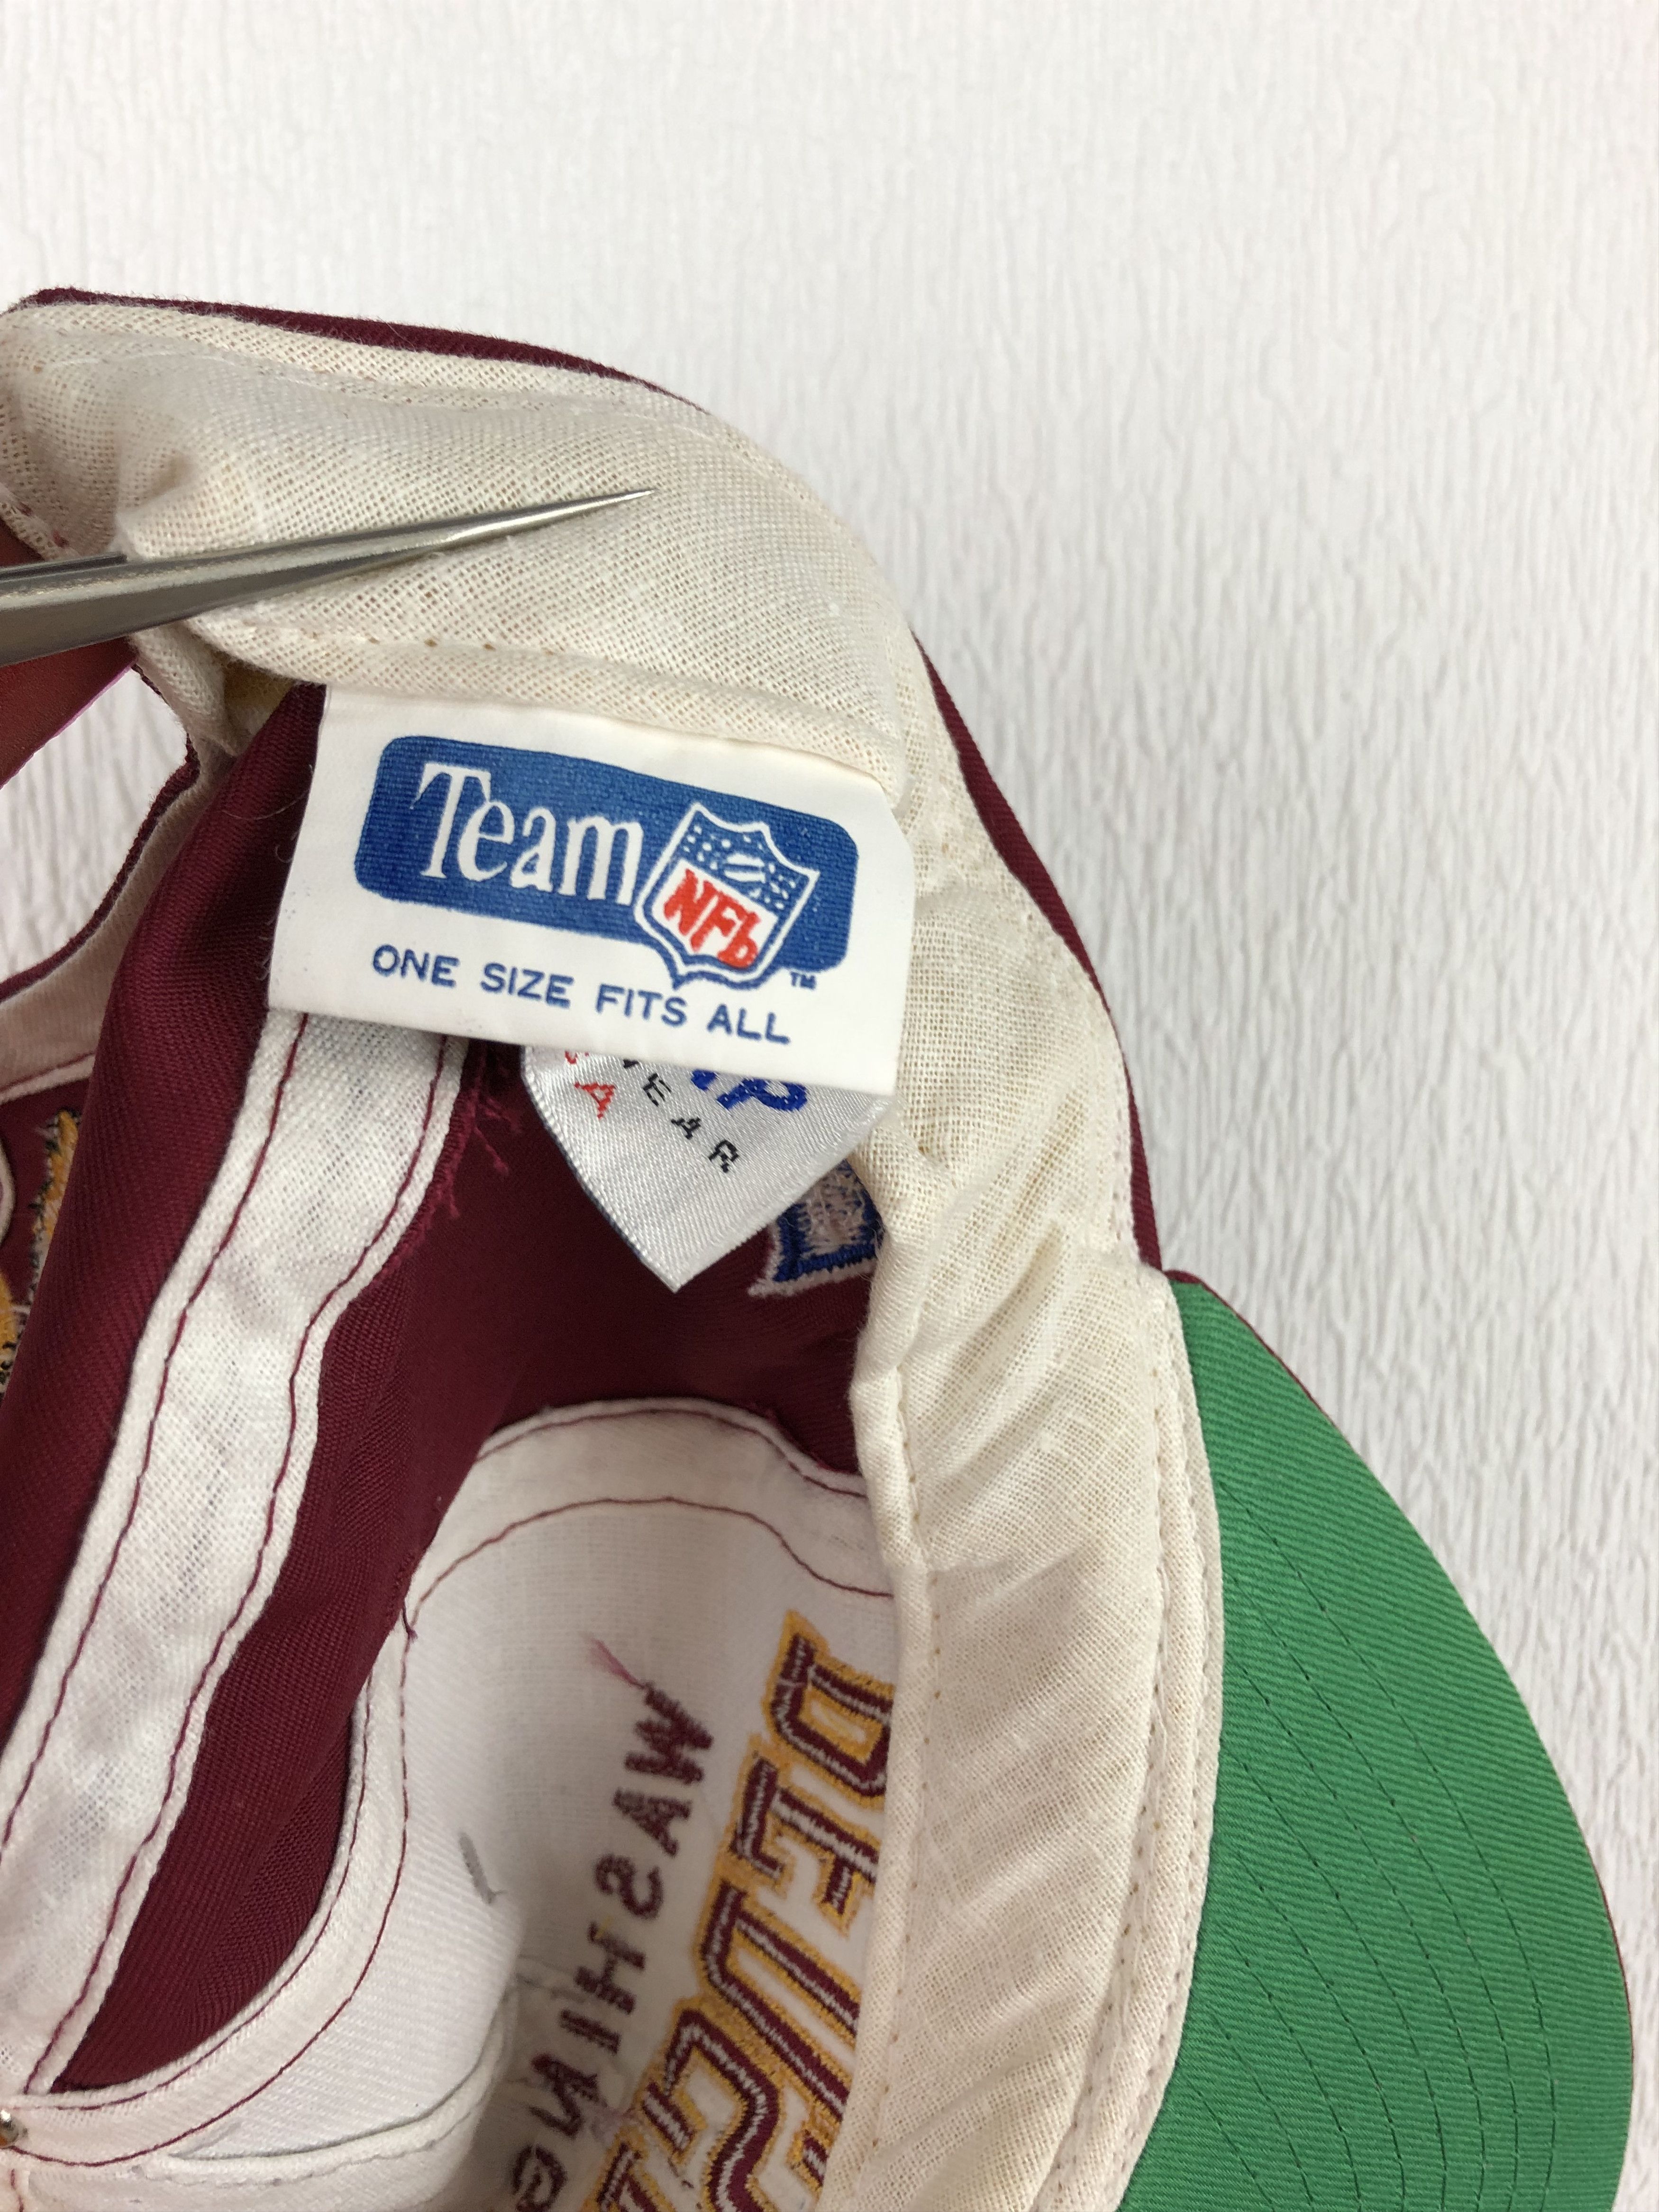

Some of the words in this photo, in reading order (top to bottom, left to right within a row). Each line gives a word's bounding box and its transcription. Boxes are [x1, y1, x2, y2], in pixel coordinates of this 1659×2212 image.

[409, 761, 645, 907] Team
[663, 868, 761, 969] NFL
[372, 944, 459, 988] ONE
[480, 962, 574, 1009] SIZE
[595, 983, 688, 1027] FITS
[706, 1004, 791, 1046] ALL
